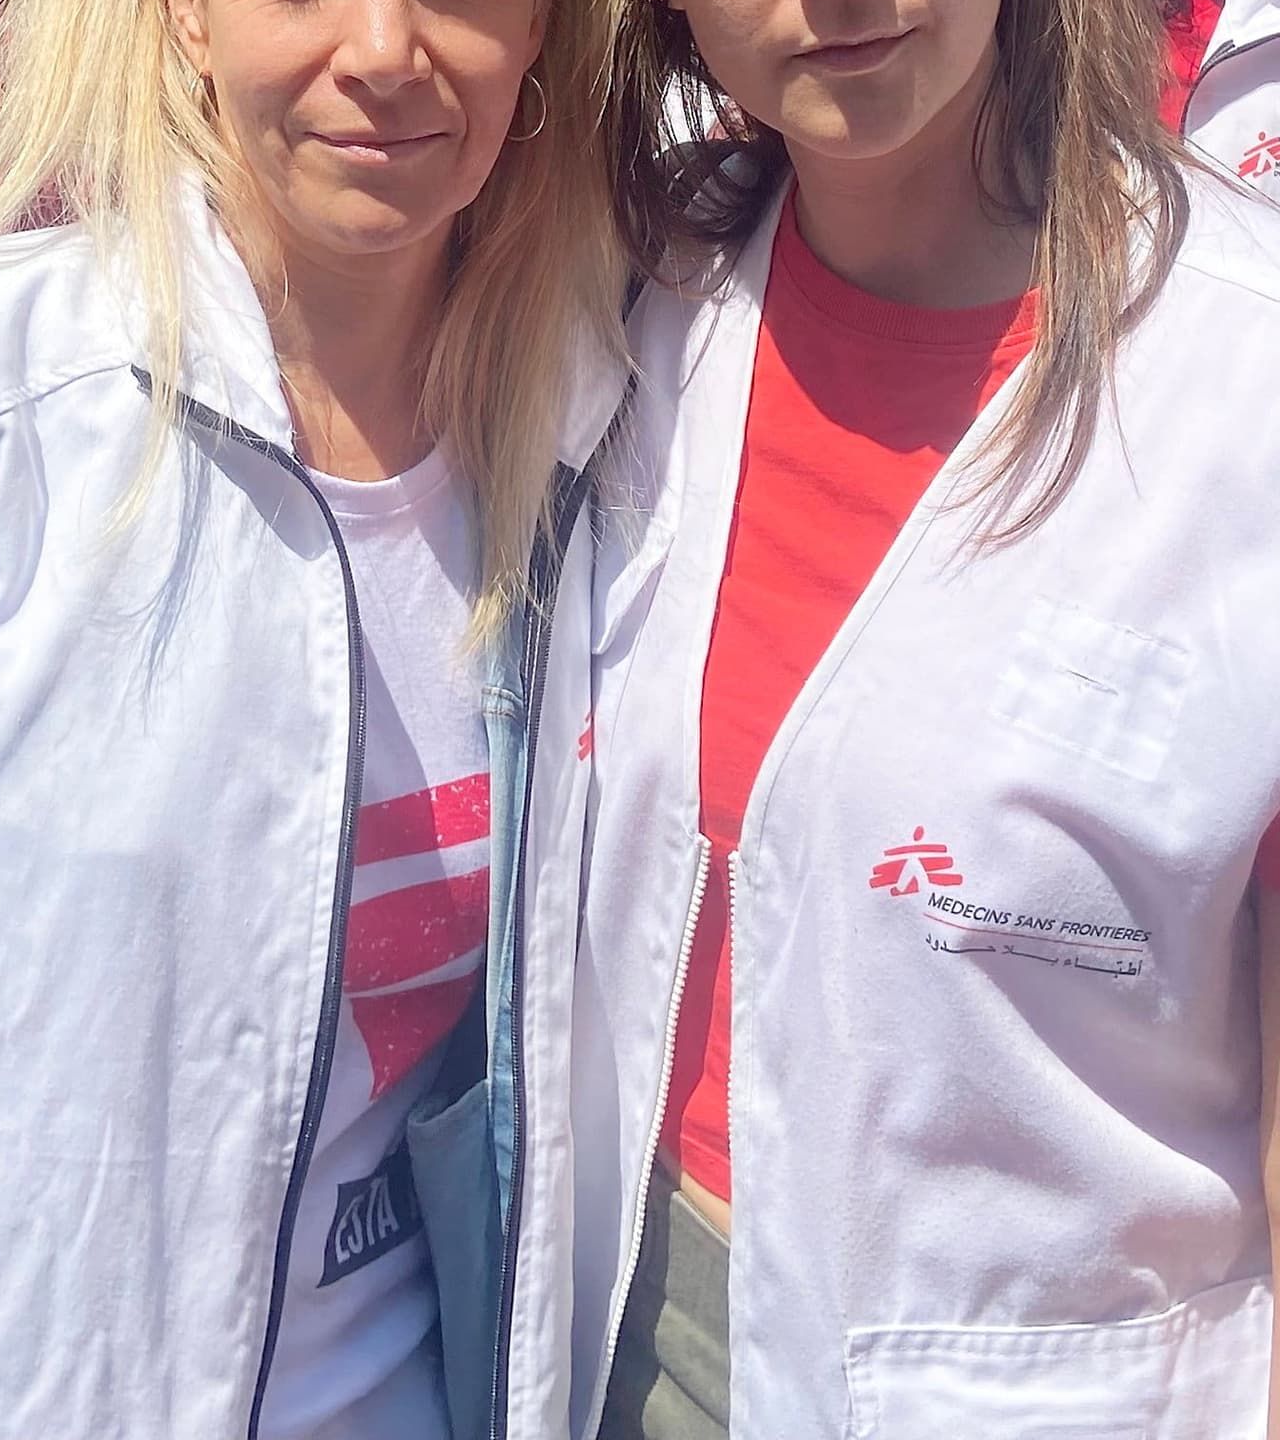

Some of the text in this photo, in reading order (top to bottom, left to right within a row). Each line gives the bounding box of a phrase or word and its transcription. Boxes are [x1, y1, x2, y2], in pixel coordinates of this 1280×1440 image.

[927, 892, 1151, 943] MEDECINS SANS FRONTIERES
